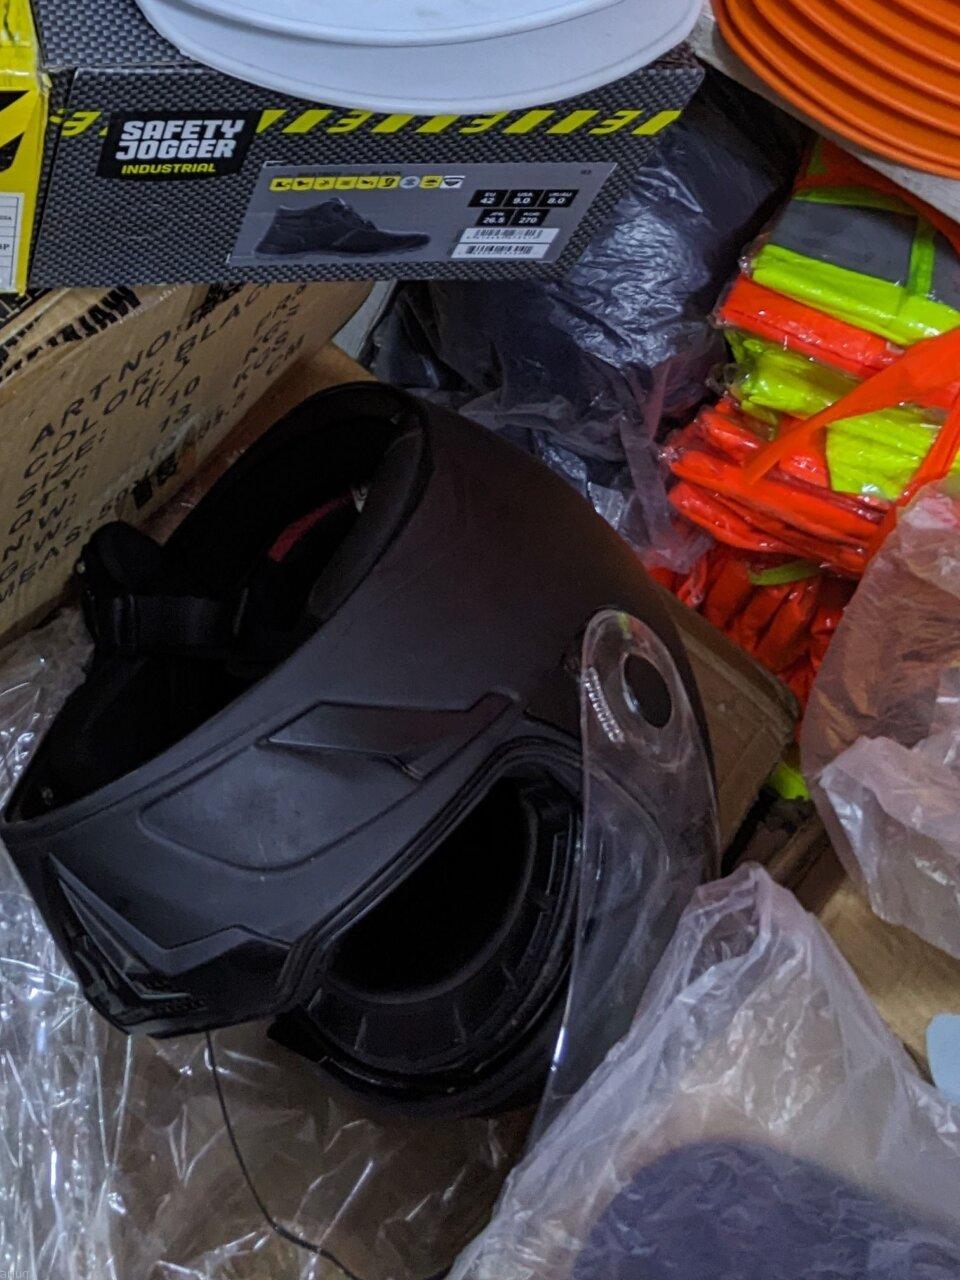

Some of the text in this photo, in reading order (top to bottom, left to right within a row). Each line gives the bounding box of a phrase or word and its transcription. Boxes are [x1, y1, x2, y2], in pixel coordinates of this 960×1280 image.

[121, 119, 246, 140] SAFETY
[115, 138, 237, 161] JOGGER
[121, 163, 216, 174] INDUSTRIAL
[174, 281, 269, 363] BLAC
